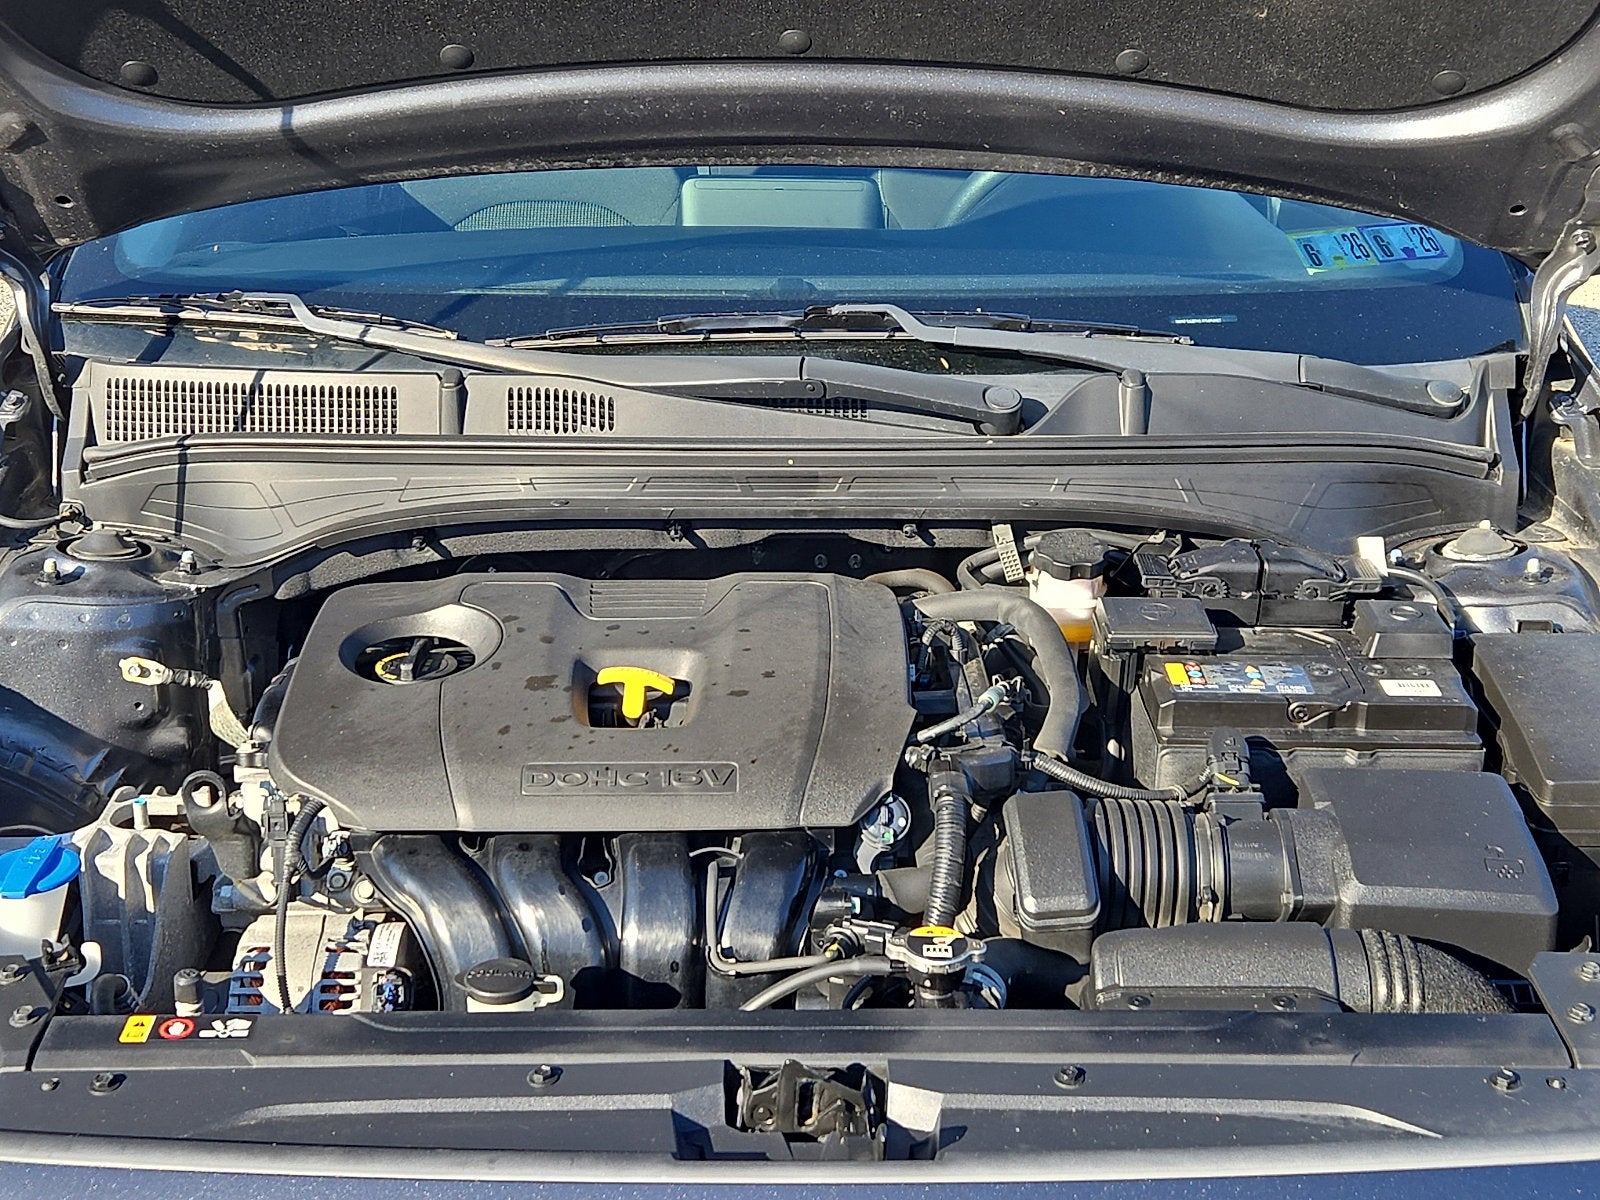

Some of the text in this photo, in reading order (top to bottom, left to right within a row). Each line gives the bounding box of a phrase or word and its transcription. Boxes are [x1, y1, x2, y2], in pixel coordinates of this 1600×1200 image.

[1302, 243, 1323, 267] 6
[1340, 232, 1371, 260] 26
[1372, 234, 1395, 258] 6
[1409, 226, 1440, 253] 26
[526, 767, 735, 788] DOHC 16V
